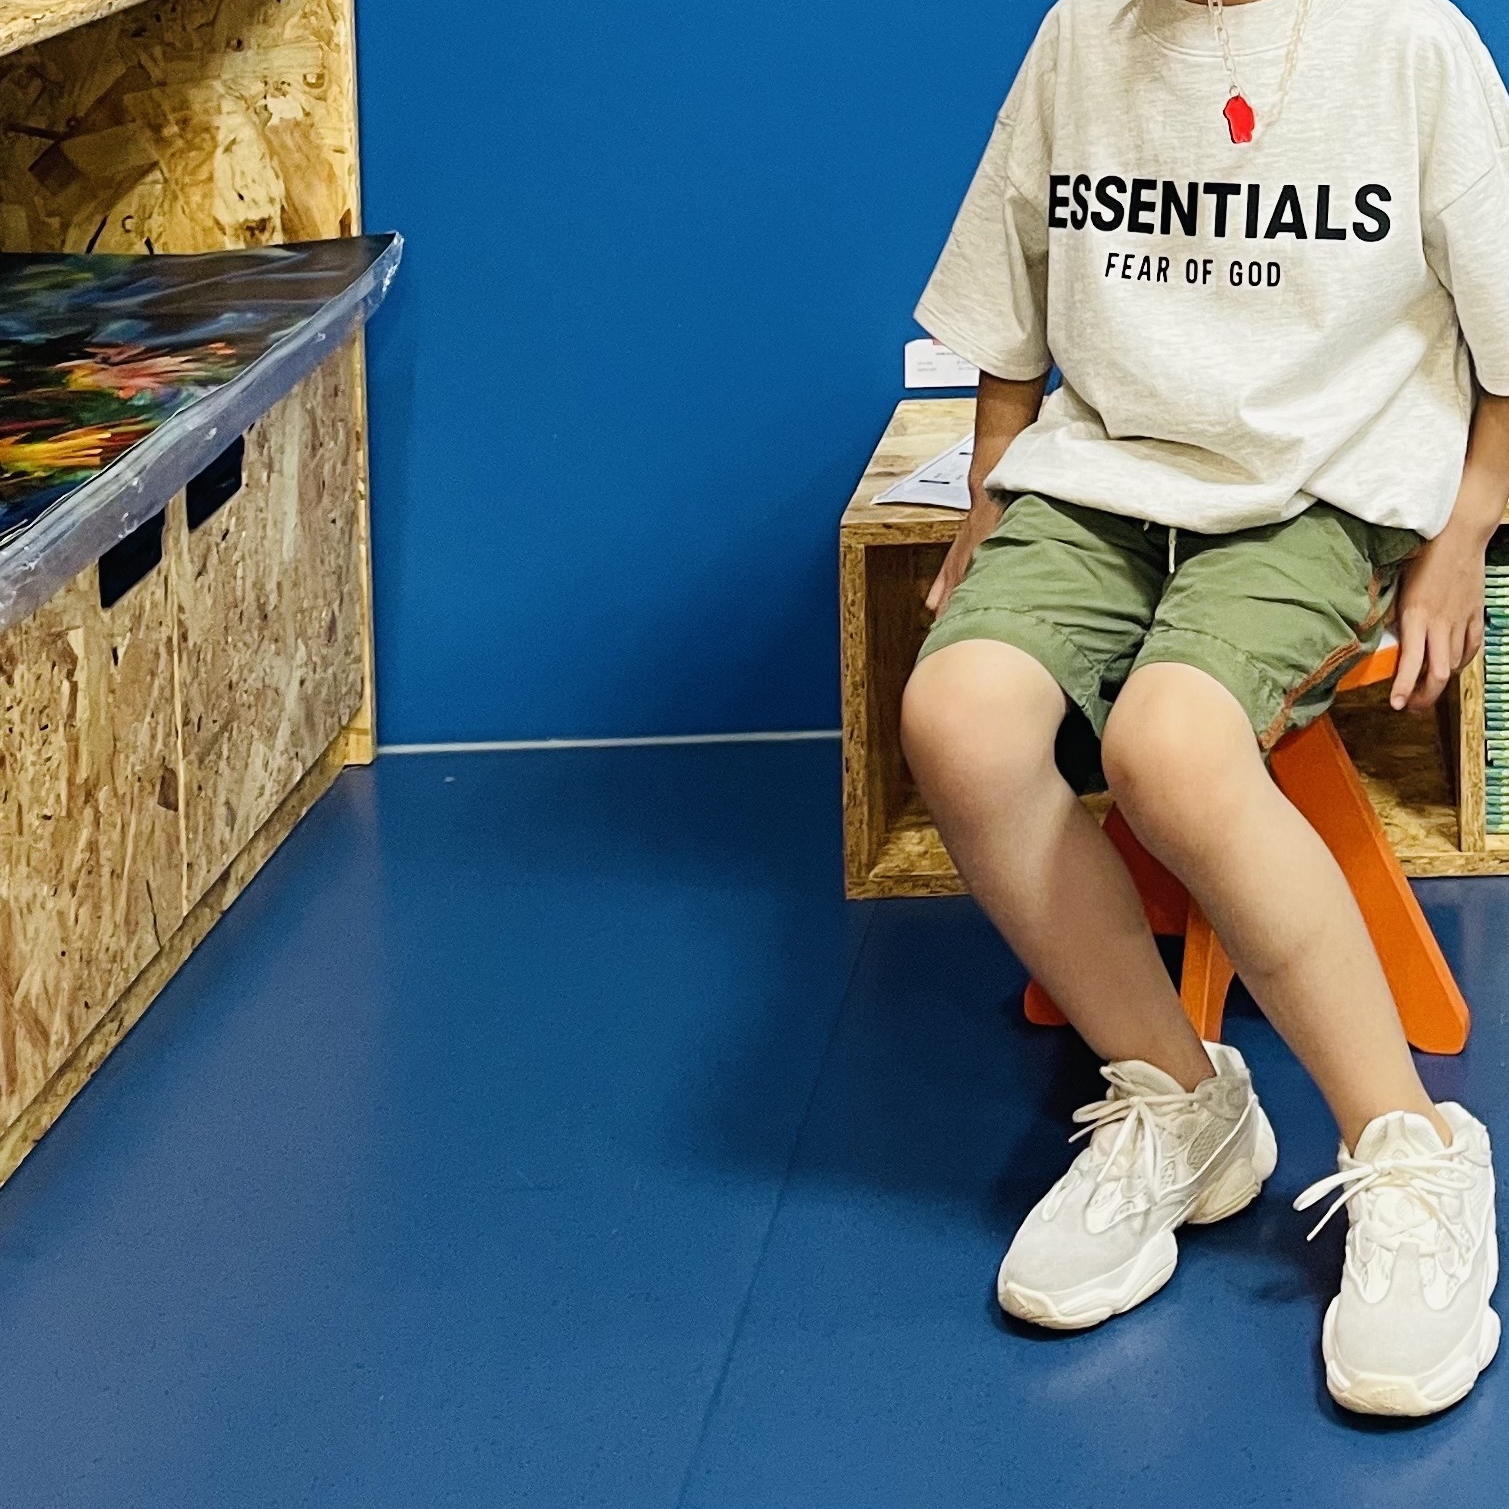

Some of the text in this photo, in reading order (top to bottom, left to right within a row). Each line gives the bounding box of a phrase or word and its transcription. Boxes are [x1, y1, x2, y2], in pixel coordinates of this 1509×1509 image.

[1049, 173, 1392, 242] ESSENTIALS
[1105, 252, 1281, 287] FEAR OF GOD
